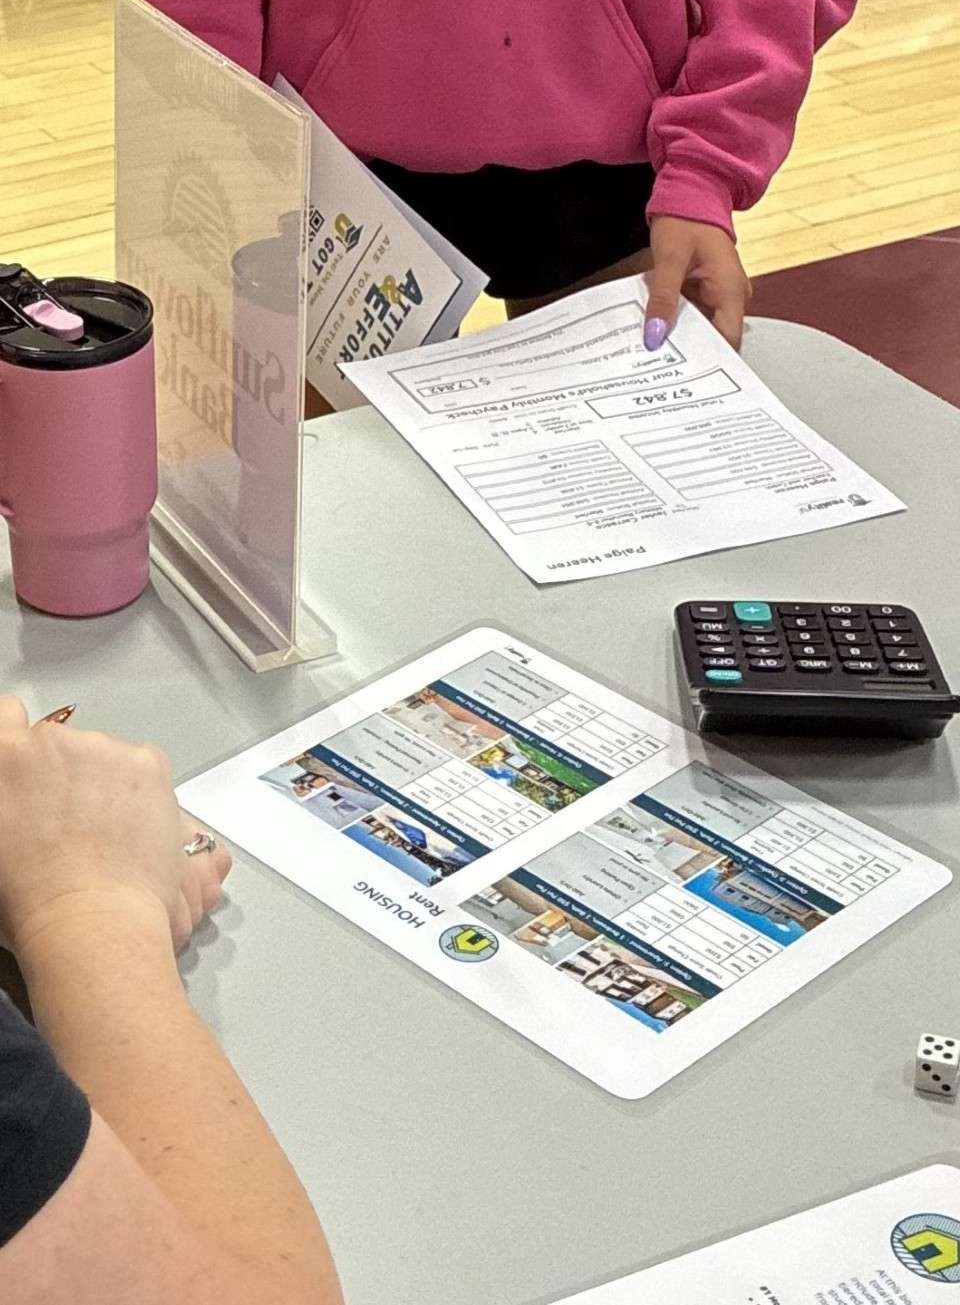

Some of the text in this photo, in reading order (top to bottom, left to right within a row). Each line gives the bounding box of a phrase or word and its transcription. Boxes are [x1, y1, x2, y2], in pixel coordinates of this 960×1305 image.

[310, 236, 336, 275] GOT
[313, 234, 390, 364] ARE YOUR FUTURE
[646, 369, 685, 380] Your
[507, 393, 568, 409] Monthly
[628, 387, 696, 406] $7,842
[443, 403, 511, 420] Paycheck
[544, 544, 647, 571] Paige Heeren
[350, 879, 428, 929] HOUSING
[404, 890, 447, 917] Rent
